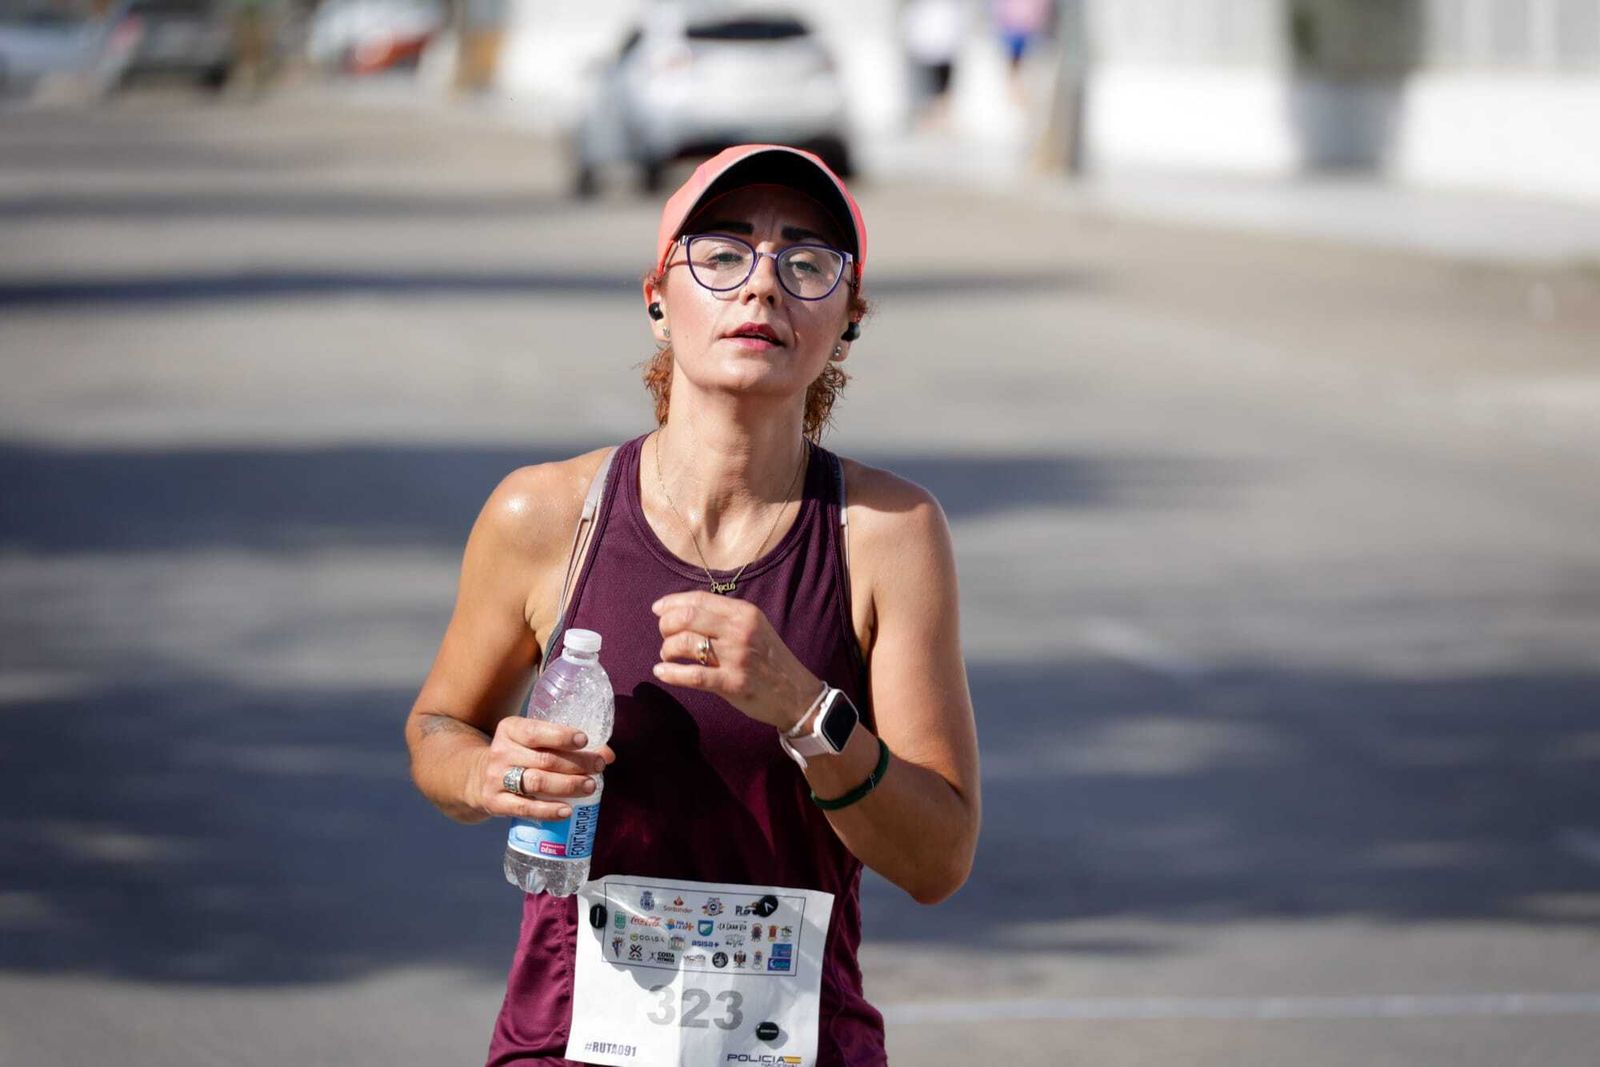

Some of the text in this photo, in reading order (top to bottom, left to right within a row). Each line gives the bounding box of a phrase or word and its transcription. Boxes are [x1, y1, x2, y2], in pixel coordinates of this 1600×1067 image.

[571, 806, 591, 855] FONT NATURA
[647, 984, 744, 1031] 323
[584, 1041, 637, 1057] #RUTA091
[727, 1054, 785, 1063] POLICIA
